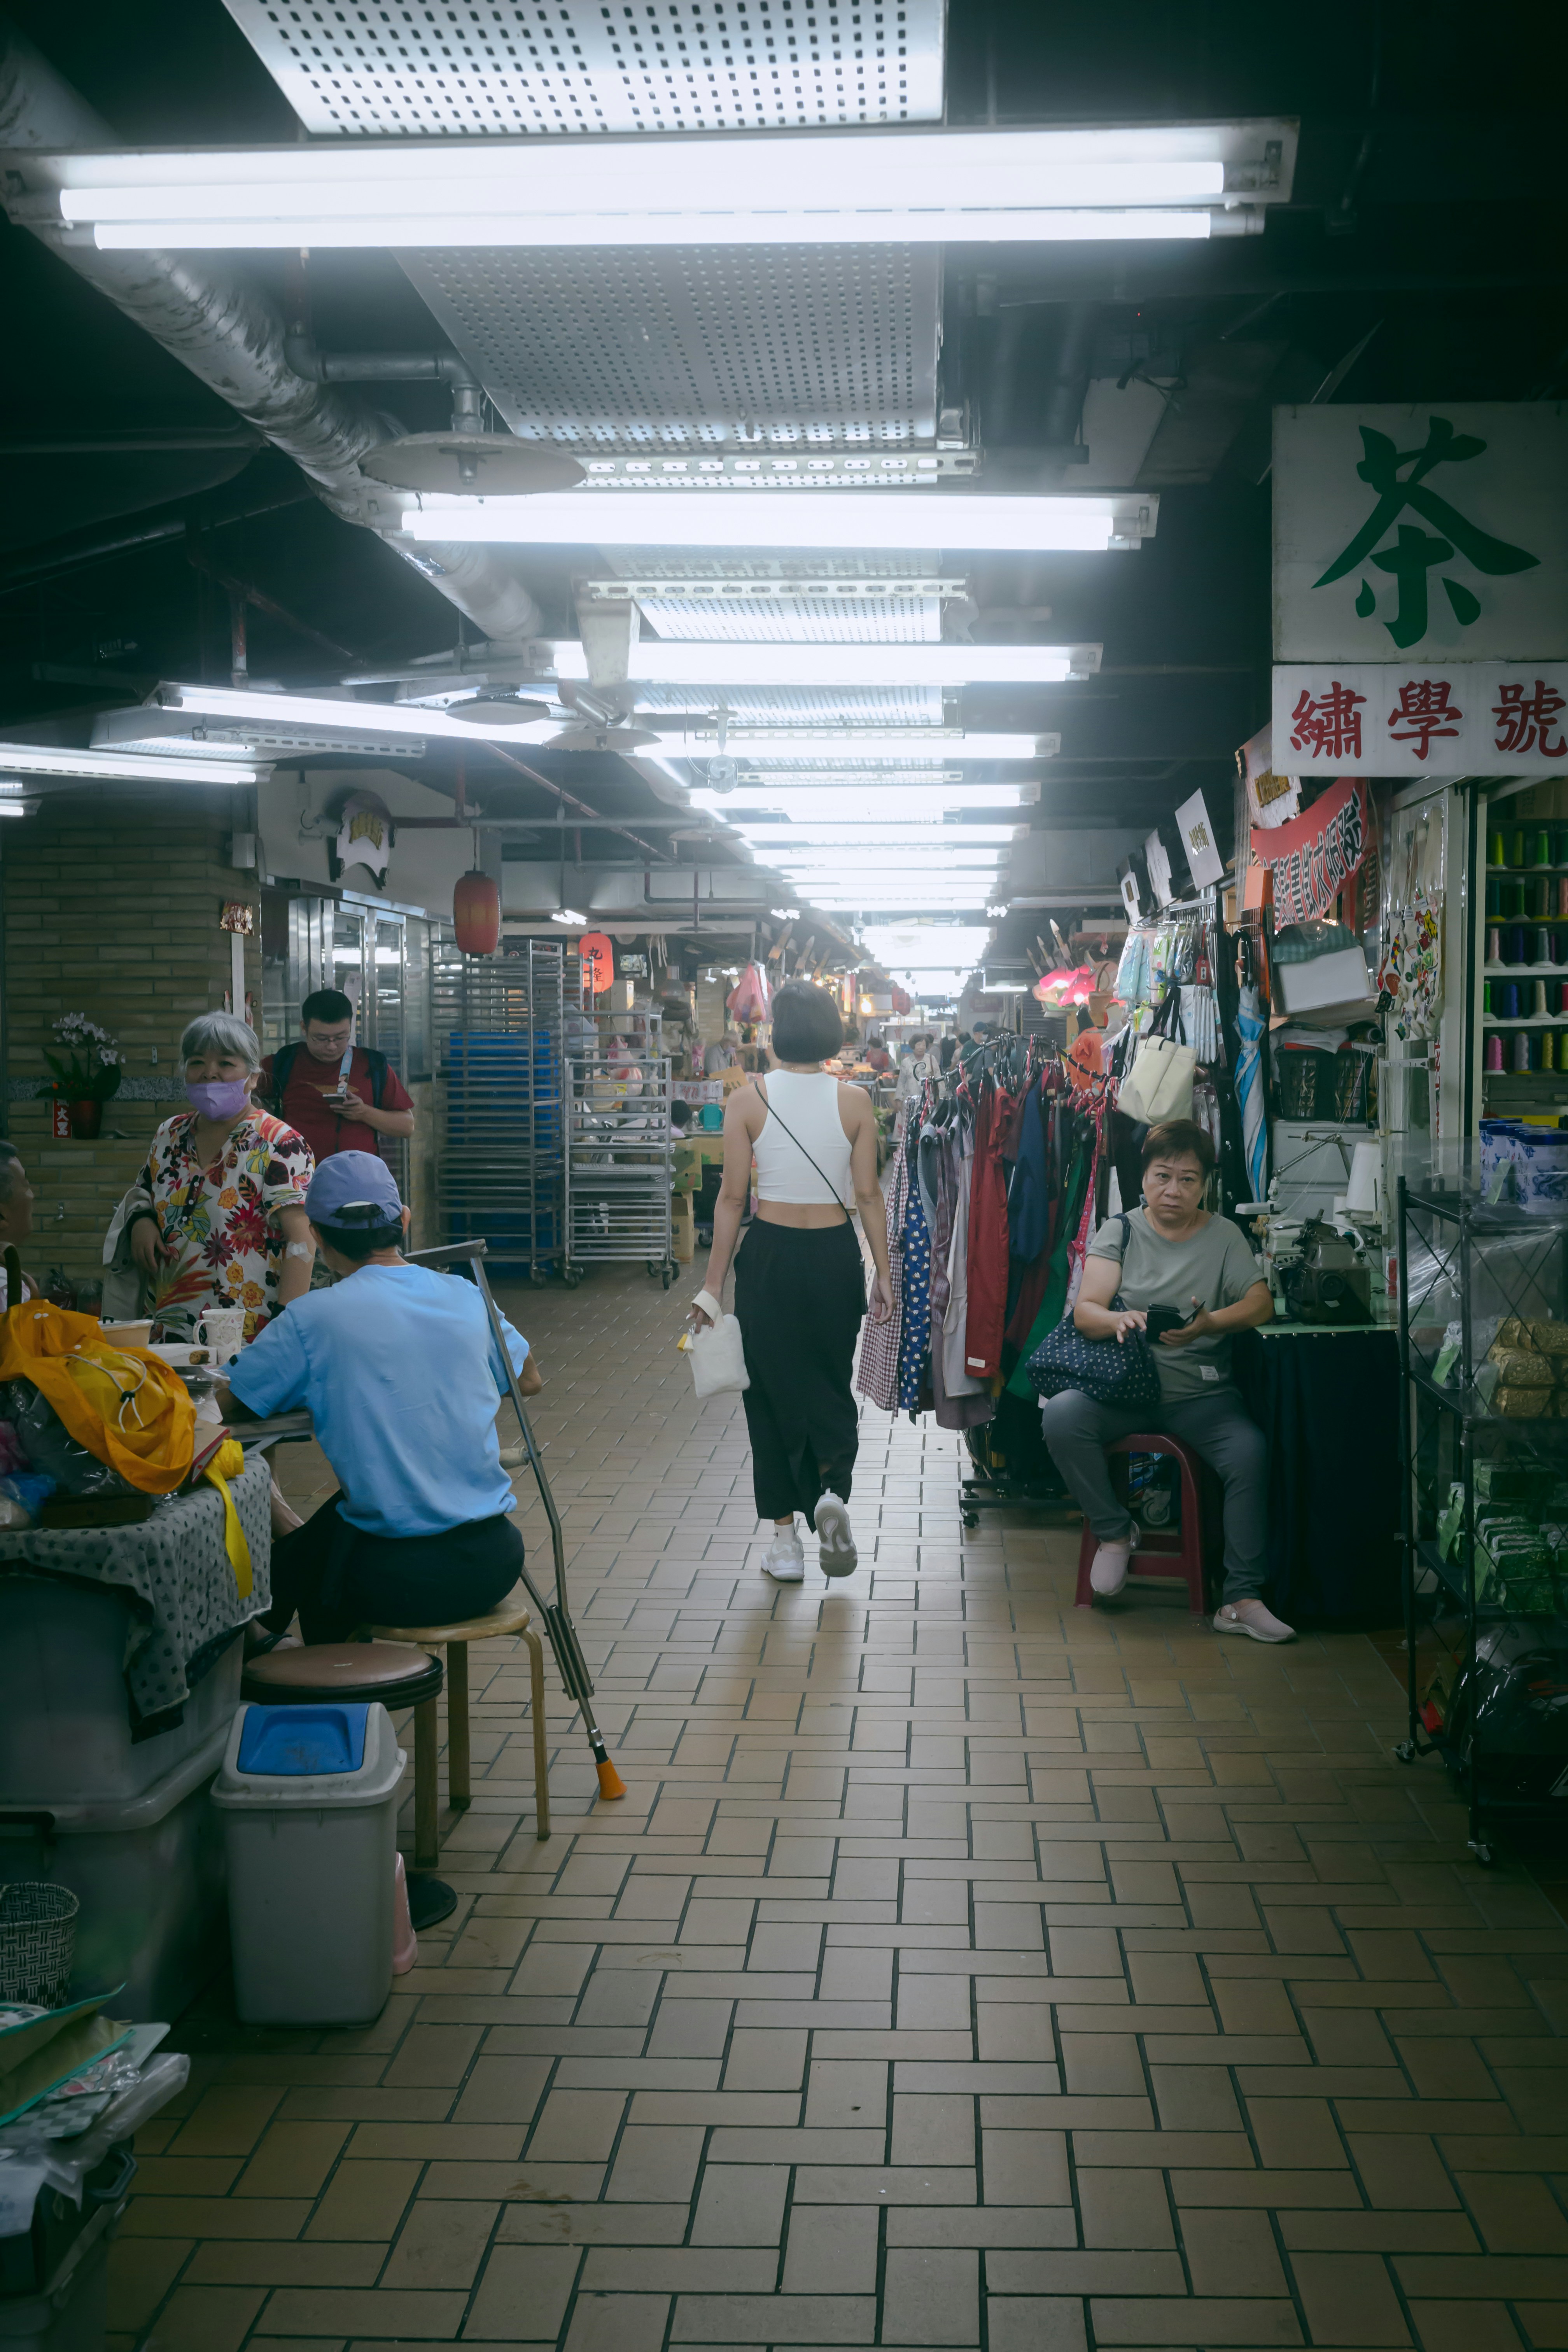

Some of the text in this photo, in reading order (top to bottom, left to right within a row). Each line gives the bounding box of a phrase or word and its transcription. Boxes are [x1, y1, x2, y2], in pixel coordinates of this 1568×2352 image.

[1312, 416, 1541, 649] 茶
[1290, 679, 1568, 761] 繡學號
